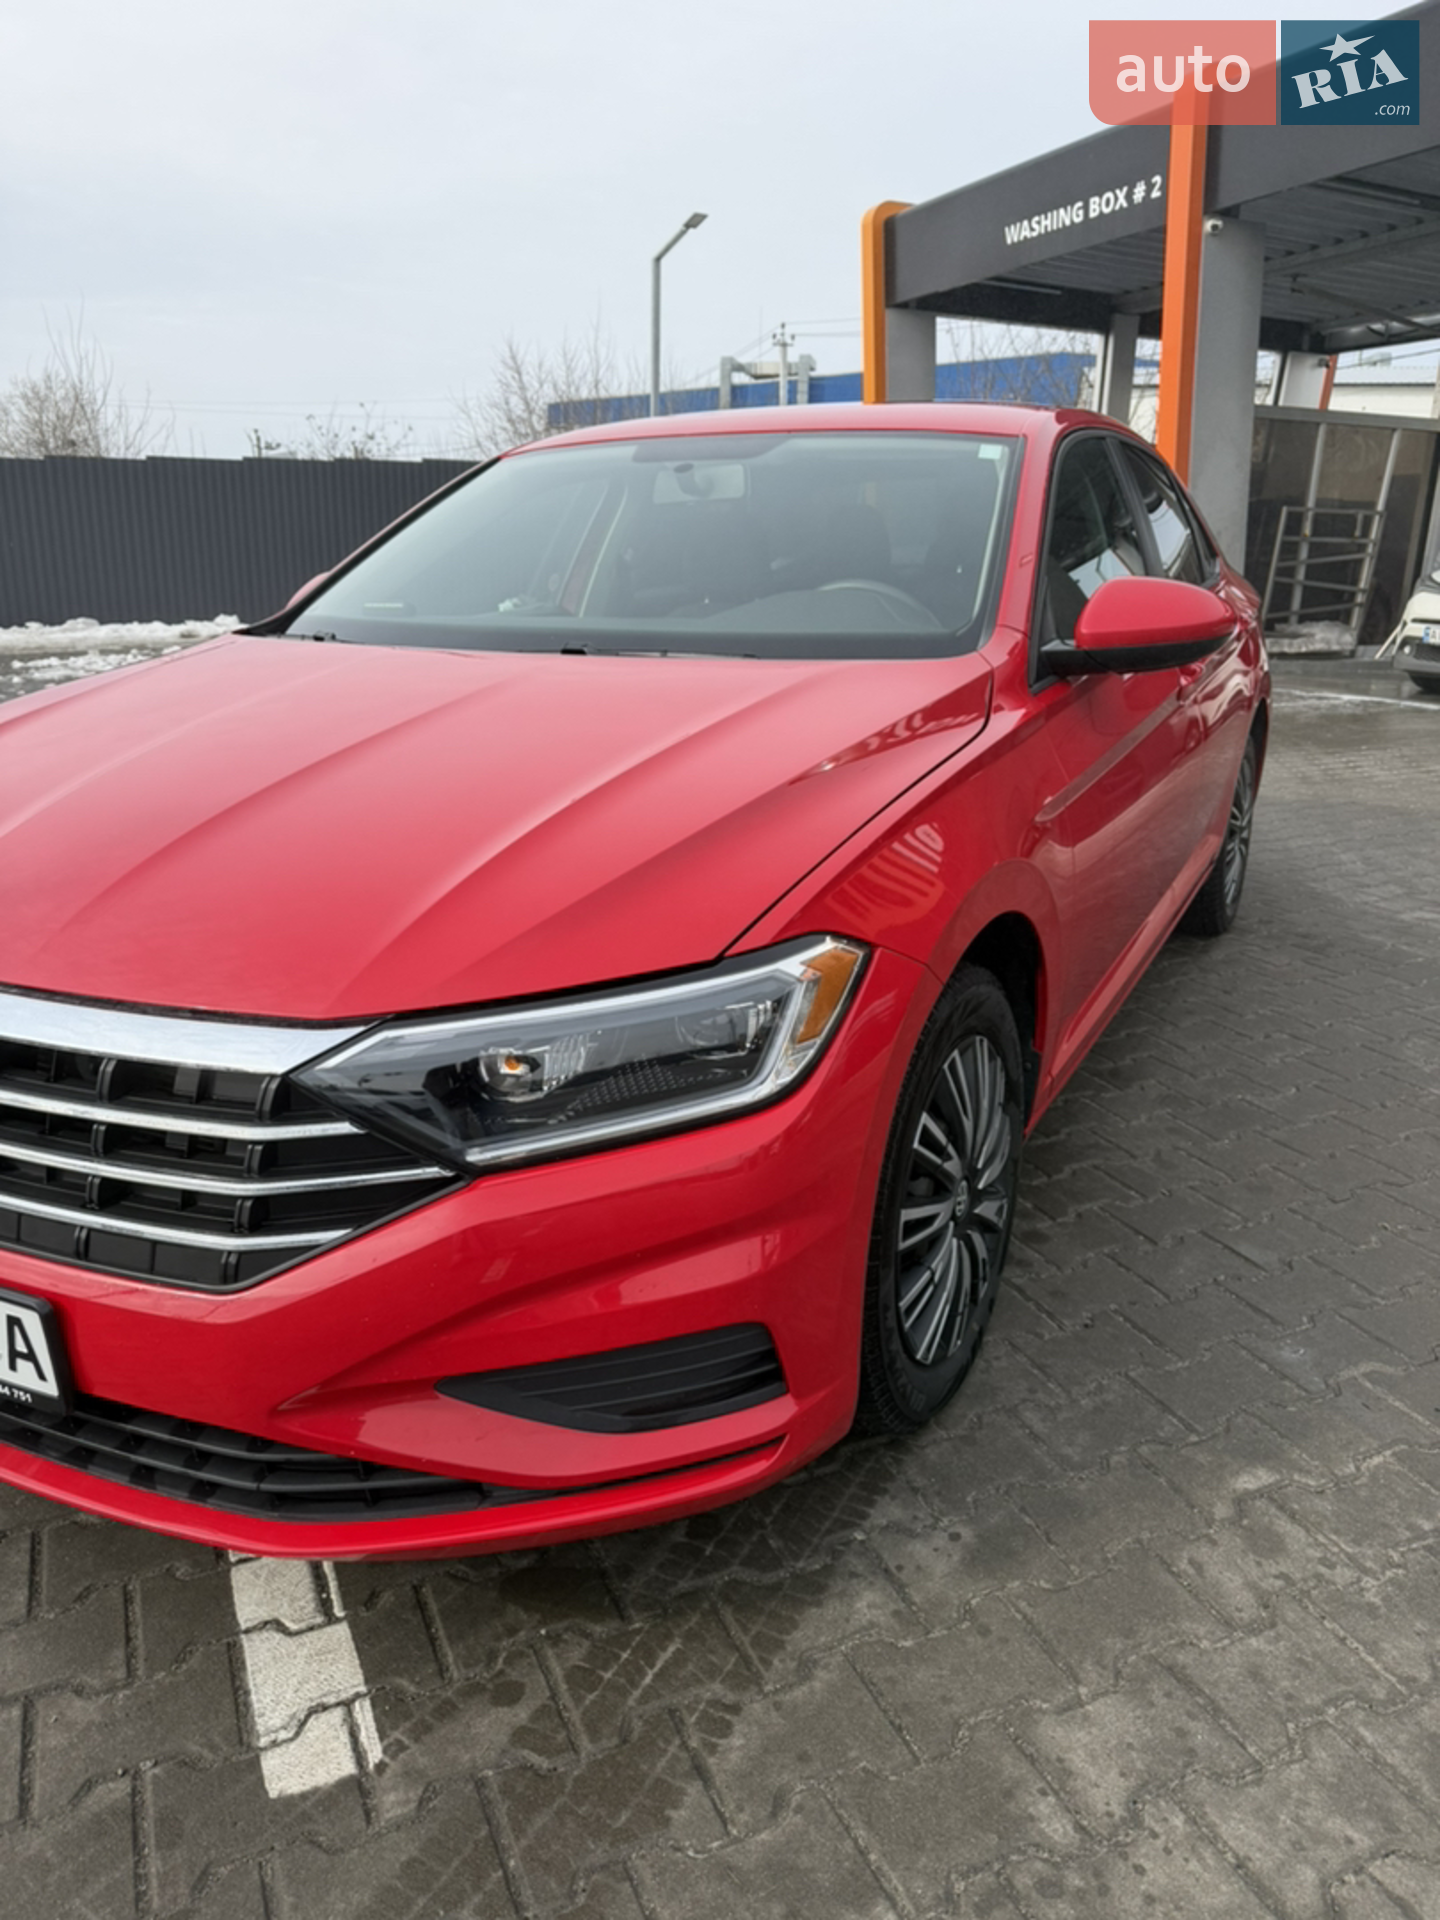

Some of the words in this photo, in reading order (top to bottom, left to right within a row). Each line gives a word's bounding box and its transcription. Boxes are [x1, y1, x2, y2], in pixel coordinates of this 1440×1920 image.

[1004, 201, 1084, 245] WASHING
[1088, 185, 1129, 219] BOX
[1132, 180, 1147, 204] #
[1150, 174, 1162, 199] 2
[0, 1313, 48, 1383] A
